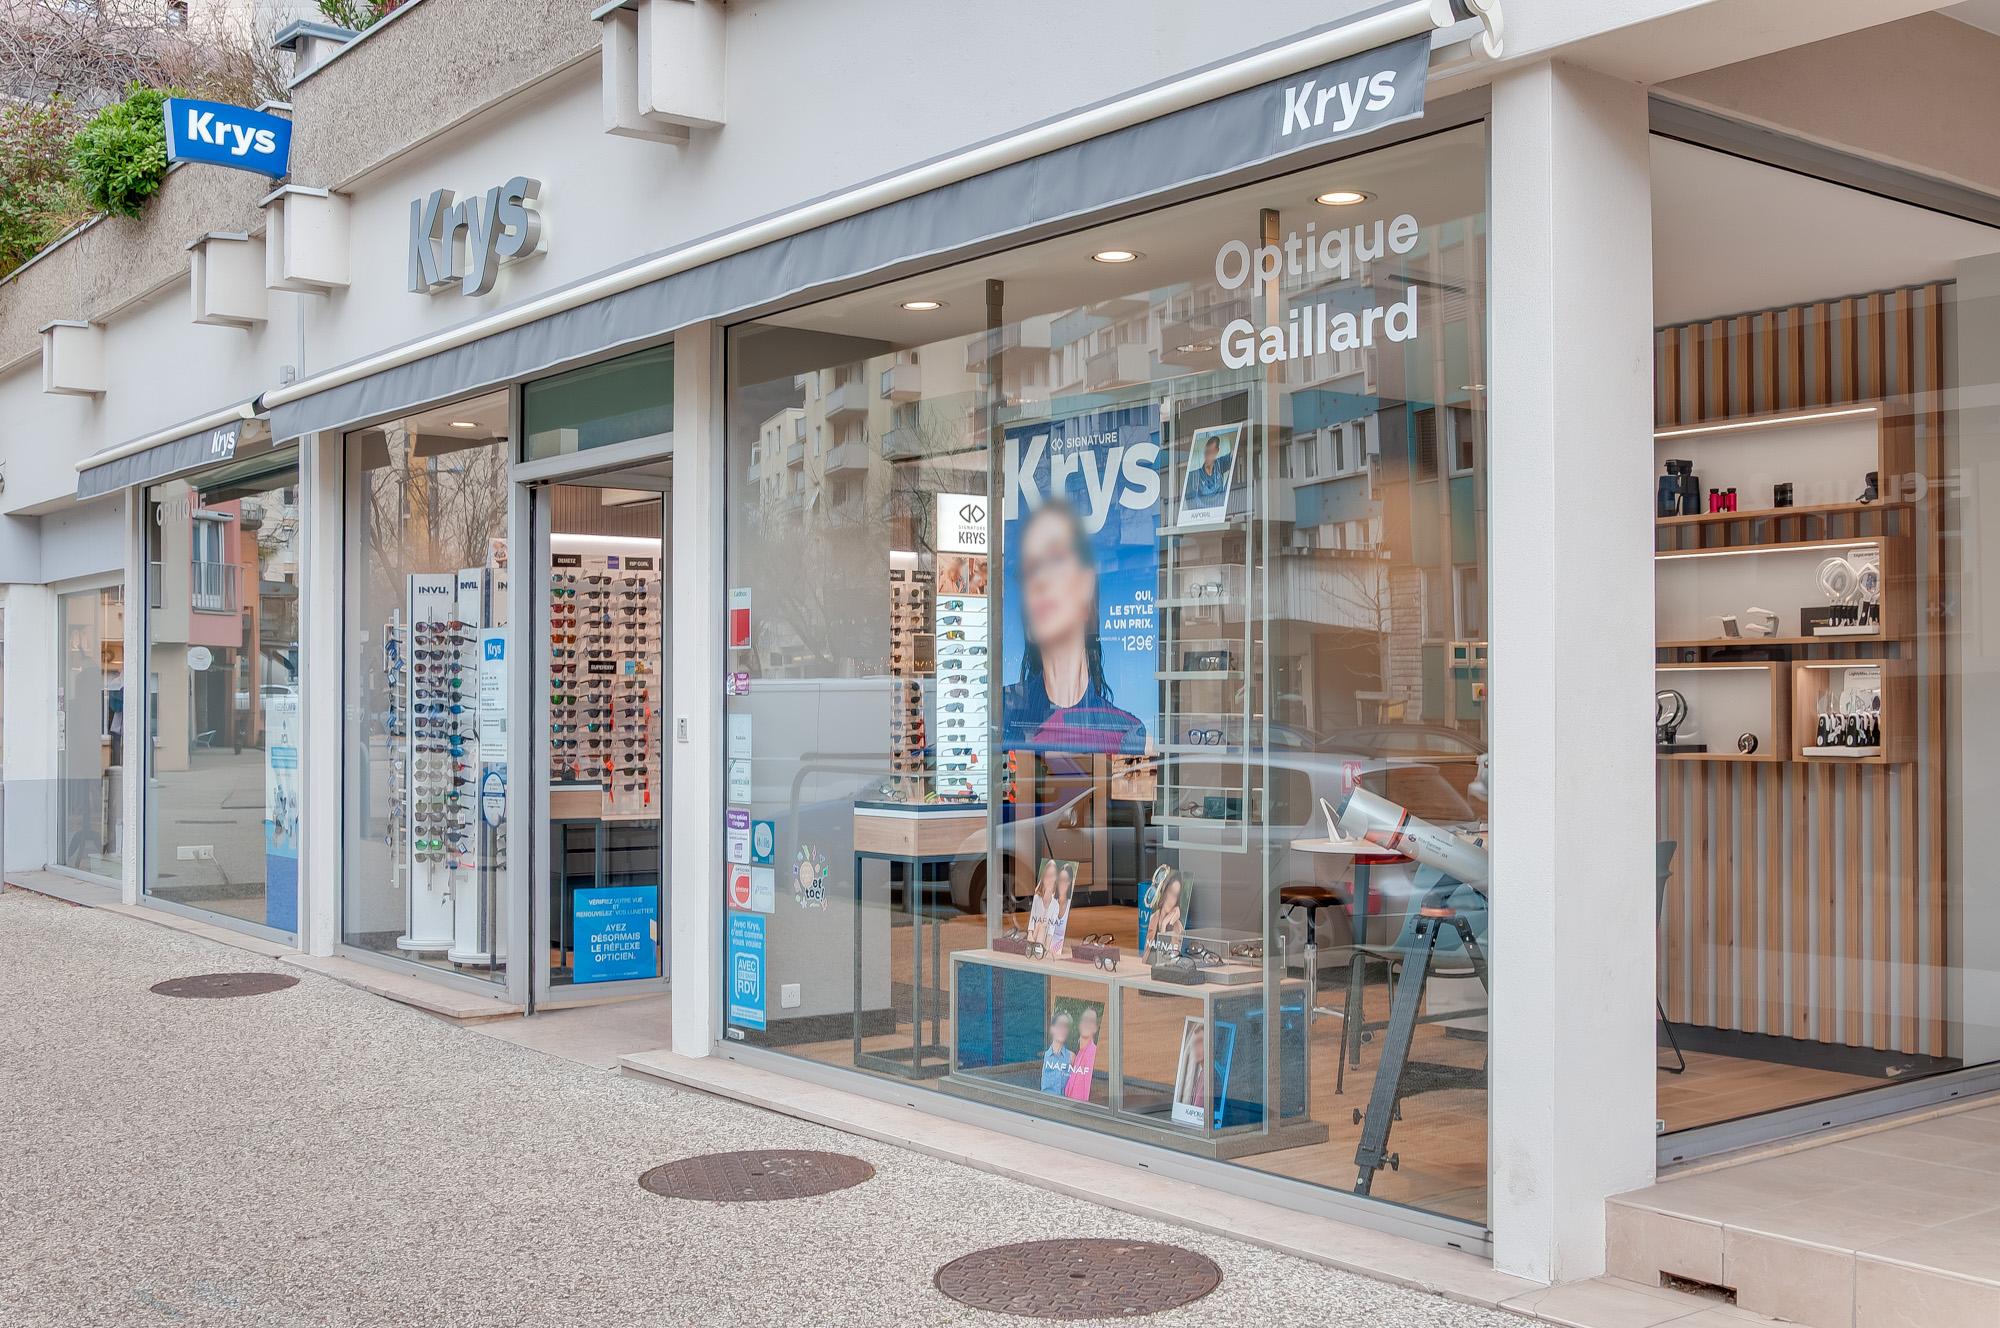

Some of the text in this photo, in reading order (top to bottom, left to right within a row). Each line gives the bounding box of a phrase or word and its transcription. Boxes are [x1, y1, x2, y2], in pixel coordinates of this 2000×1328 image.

[1282, 71, 1397, 136] Krys
[188, 109, 276, 156] Krys
[408, 176, 541, 297] Krys
[1215, 214, 1419, 297] Optique
[1220, 285, 1418, 370] Gaillard
[211, 431, 235, 456] Krys
[1066, 432, 1118, 448] SIGNATURE
[1004, 434, 1160, 535] Krys
[958, 531, 986, 545] KRYS
[1135, 590, 1153, 602] OUI,
[1110, 604, 1153, 616] LE STYLE
[1113, 619, 1126, 629] UN
[1128, 617, 1153, 629] PRIX.
[487, 643, 502, 657] Krys
[813, 878, 821, 889] et
[806, 887, 824, 902] toc!
[605, 922, 627, 932] AYEZ
[591, 931, 641, 943] DÉSORMAIS
[591, 940, 641, 953] LE RÉFLEXE
[1161, 941, 1178, 952] NAF
[595, 951, 636, 963] OPTICIEN.
[738, 959, 756, 972] AVEC
[738, 980, 757, 995] RDV
[1045, 1060, 1067, 1071] NAF
[1068, 1064, 1090, 1075] NAF
